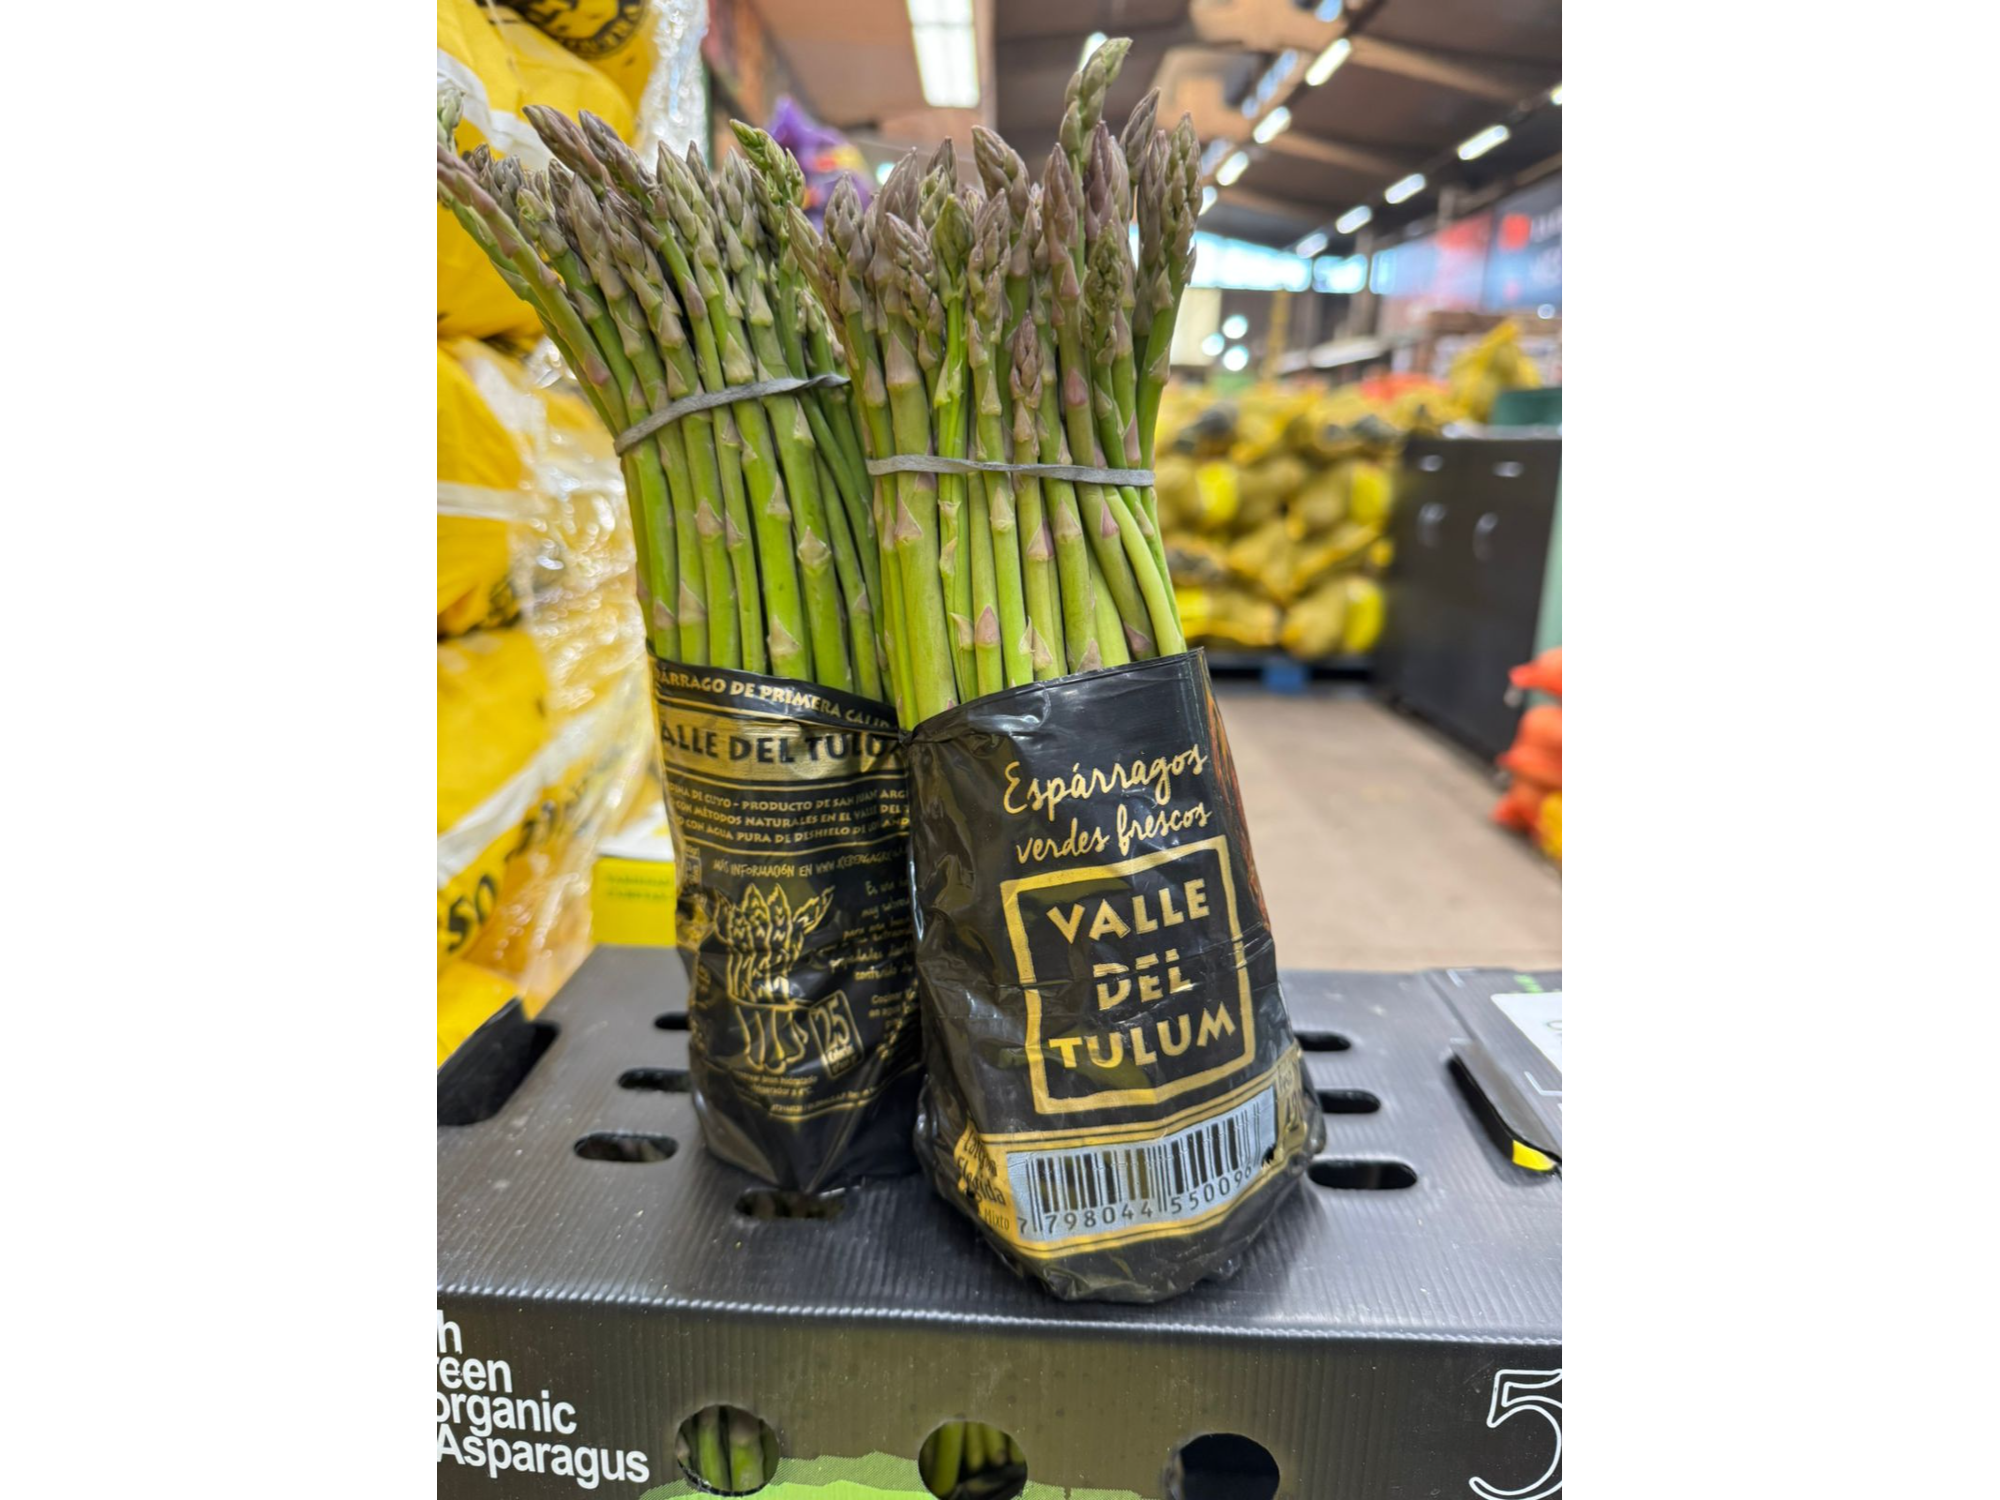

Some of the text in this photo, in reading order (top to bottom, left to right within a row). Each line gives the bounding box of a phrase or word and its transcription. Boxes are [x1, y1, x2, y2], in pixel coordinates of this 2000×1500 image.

[729, 681, 755, 698] DE
[760, 685, 842, 718] PRIMERA
[729, 736, 795, 763] DEL
[742, 800, 813, 812] PRODUCTO
[816, 799, 831, 809] DE
[880, 788, 909, 800] ARG
[1003, 744, 1208, 822] Espárragos
[675, 799, 693, 813] CON
[694, 806, 743, 825] MÉTODOS
[745, 814, 819, 829] NATURALES
[821, 812, 837, 823] EN
[839, 811, 852, 821] EL
[880, 803, 901, 815] DEL
[685, 818, 705, 832] CON
[706, 824, 734, 840] AGUA
[736, 831, 772, 843] PURA
[775, 833, 792, 845] DE
[794, 825, 850, 843] DESHIELO
[1016, 802, 1213, 864] verdes frescos
[798, 863, 813, 878] EN
[1046, 878, 1211, 944] VALLE
[1093, 947, 1194, 1012] DEL
[1048, 1001, 1237, 1069] TULUM
[1017, 1216, 1029, 1235] 7
[1045, 1205, 1154, 1236] 798044
[437, 1390, 578, 1437] organic
[437, 1423, 650, 1489] Asparagus
